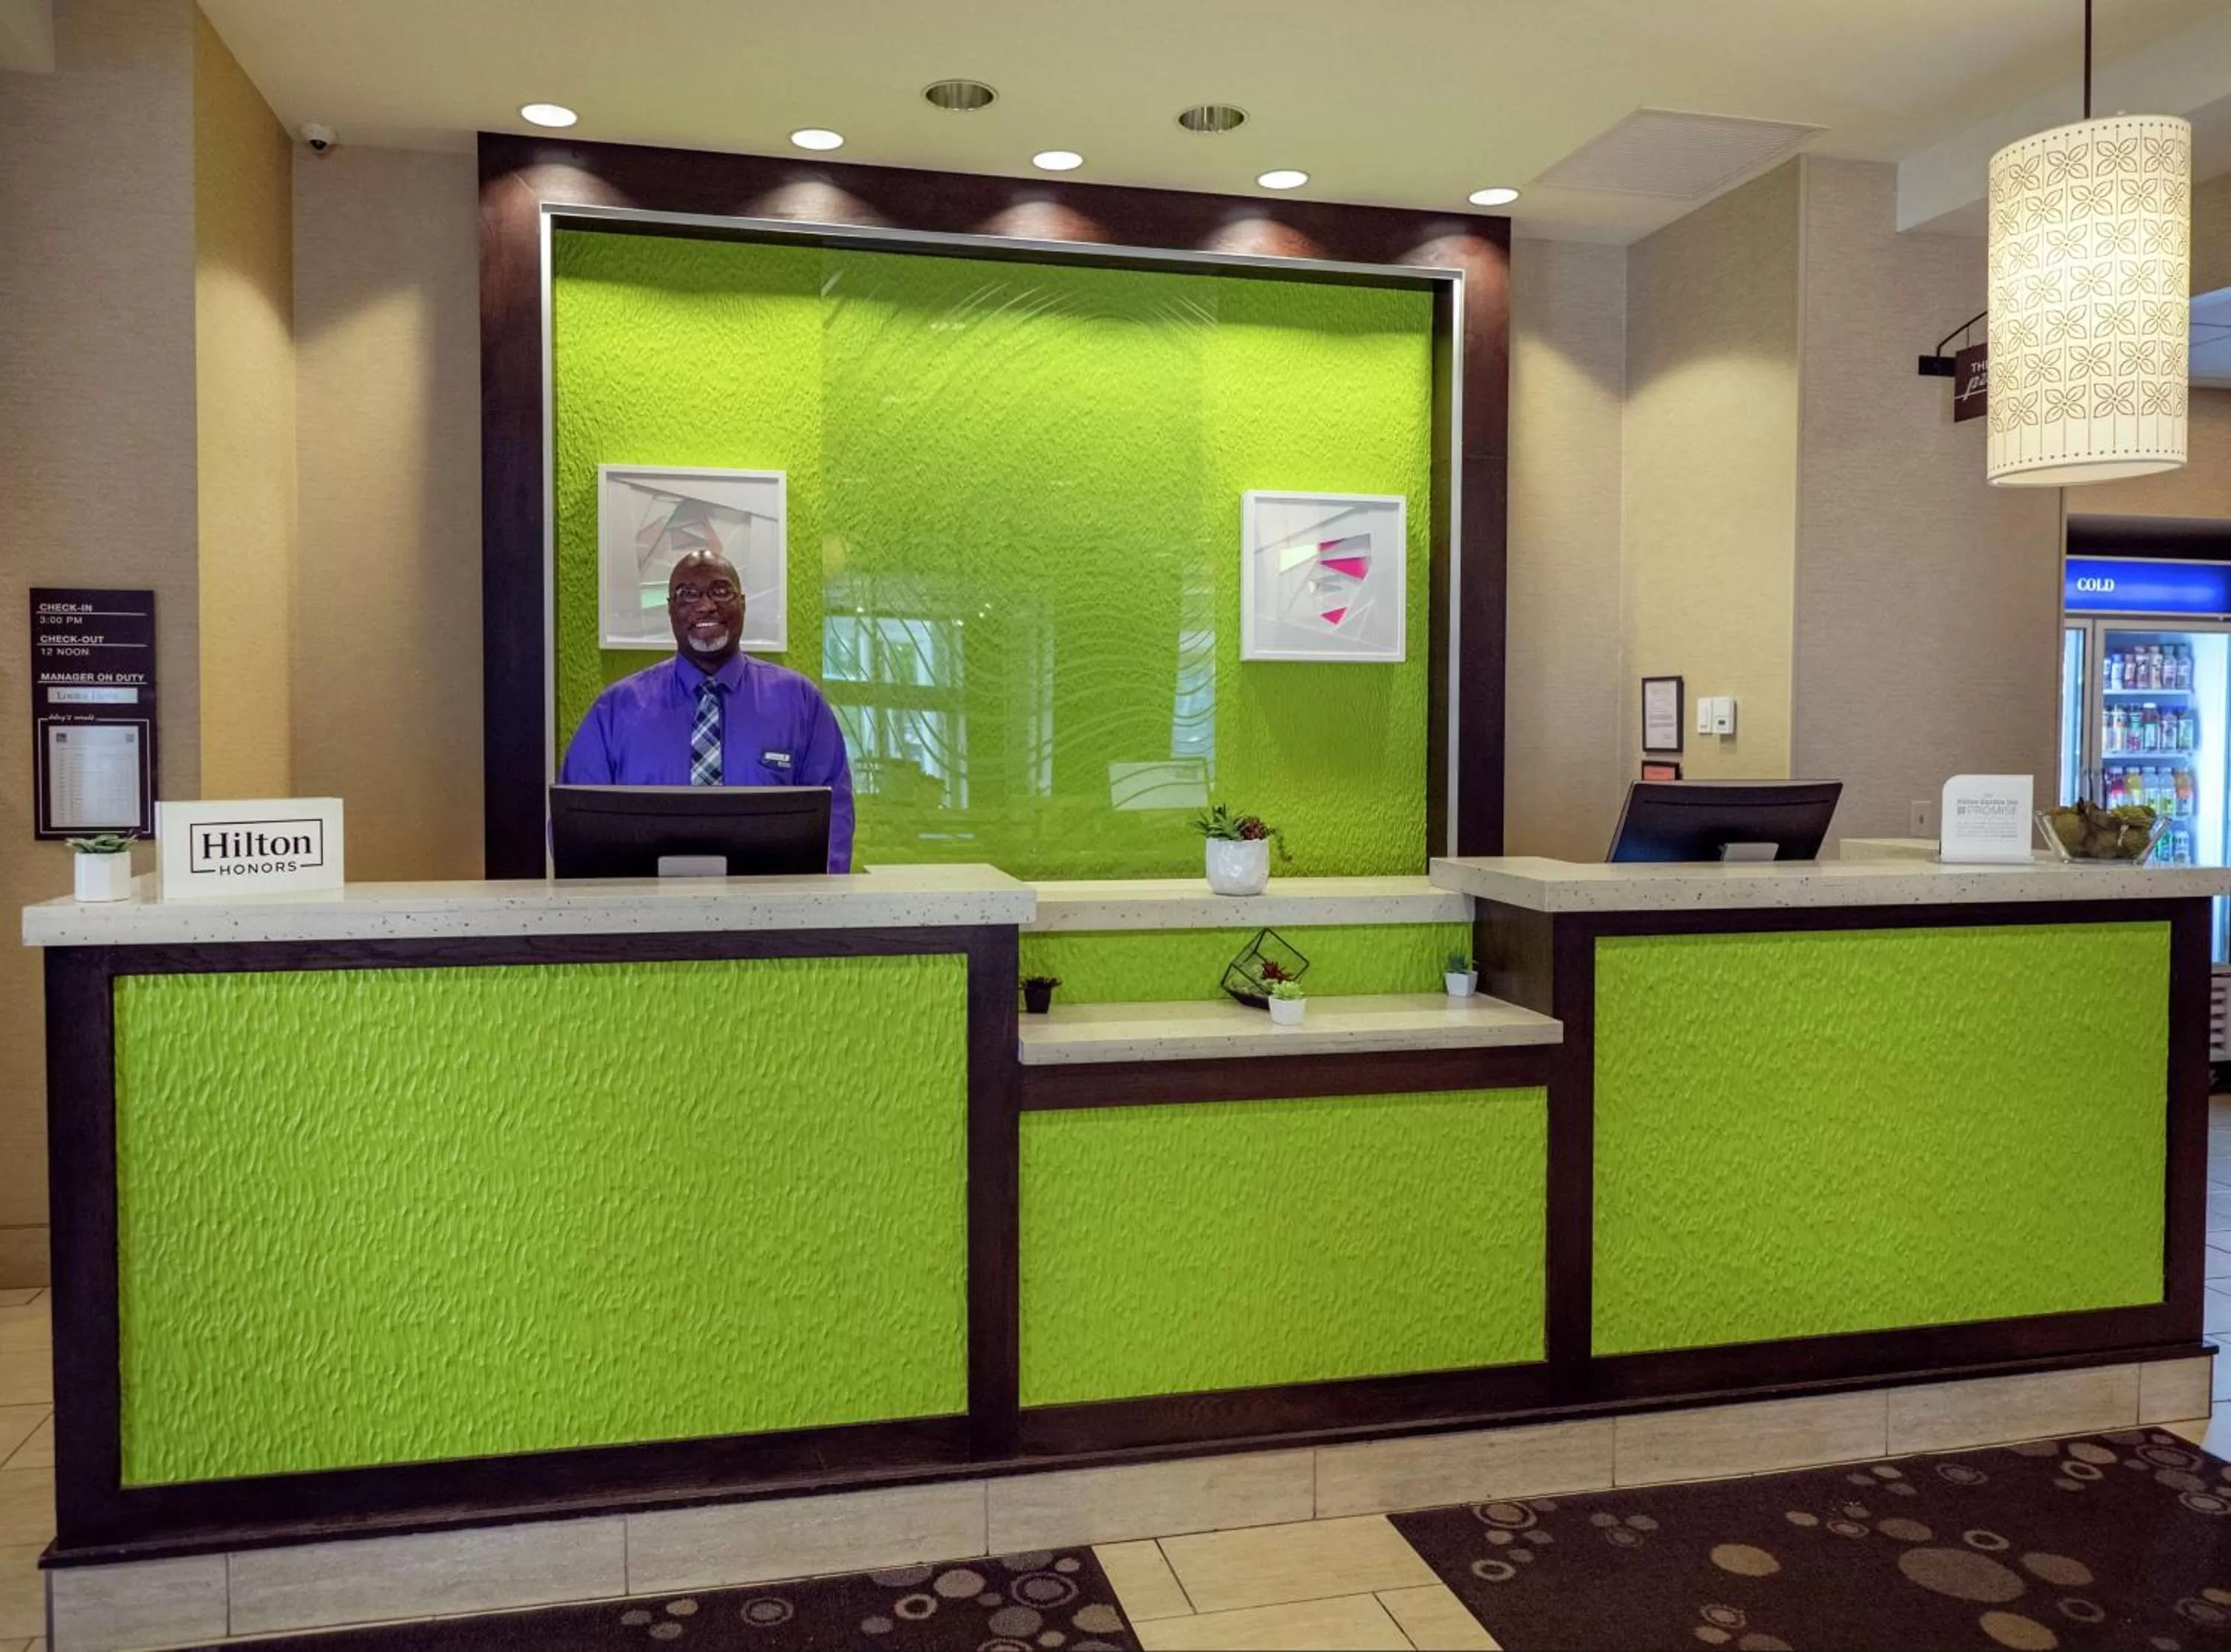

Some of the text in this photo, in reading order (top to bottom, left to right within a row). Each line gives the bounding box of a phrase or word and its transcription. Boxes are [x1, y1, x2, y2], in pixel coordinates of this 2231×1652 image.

[2076, 577, 2115, 592] COLD
[39, 603, 93, 612] CHECK-IN
[39, 616, 83, 625] 3:00 PM
[39, 635, 104, 644] CHECK-OUT
[41, 673, 144, 682] MANAGER ON DUTY
[202, 831, 312, 859] Hilton
[219, 861, 297, 876] HONORS
